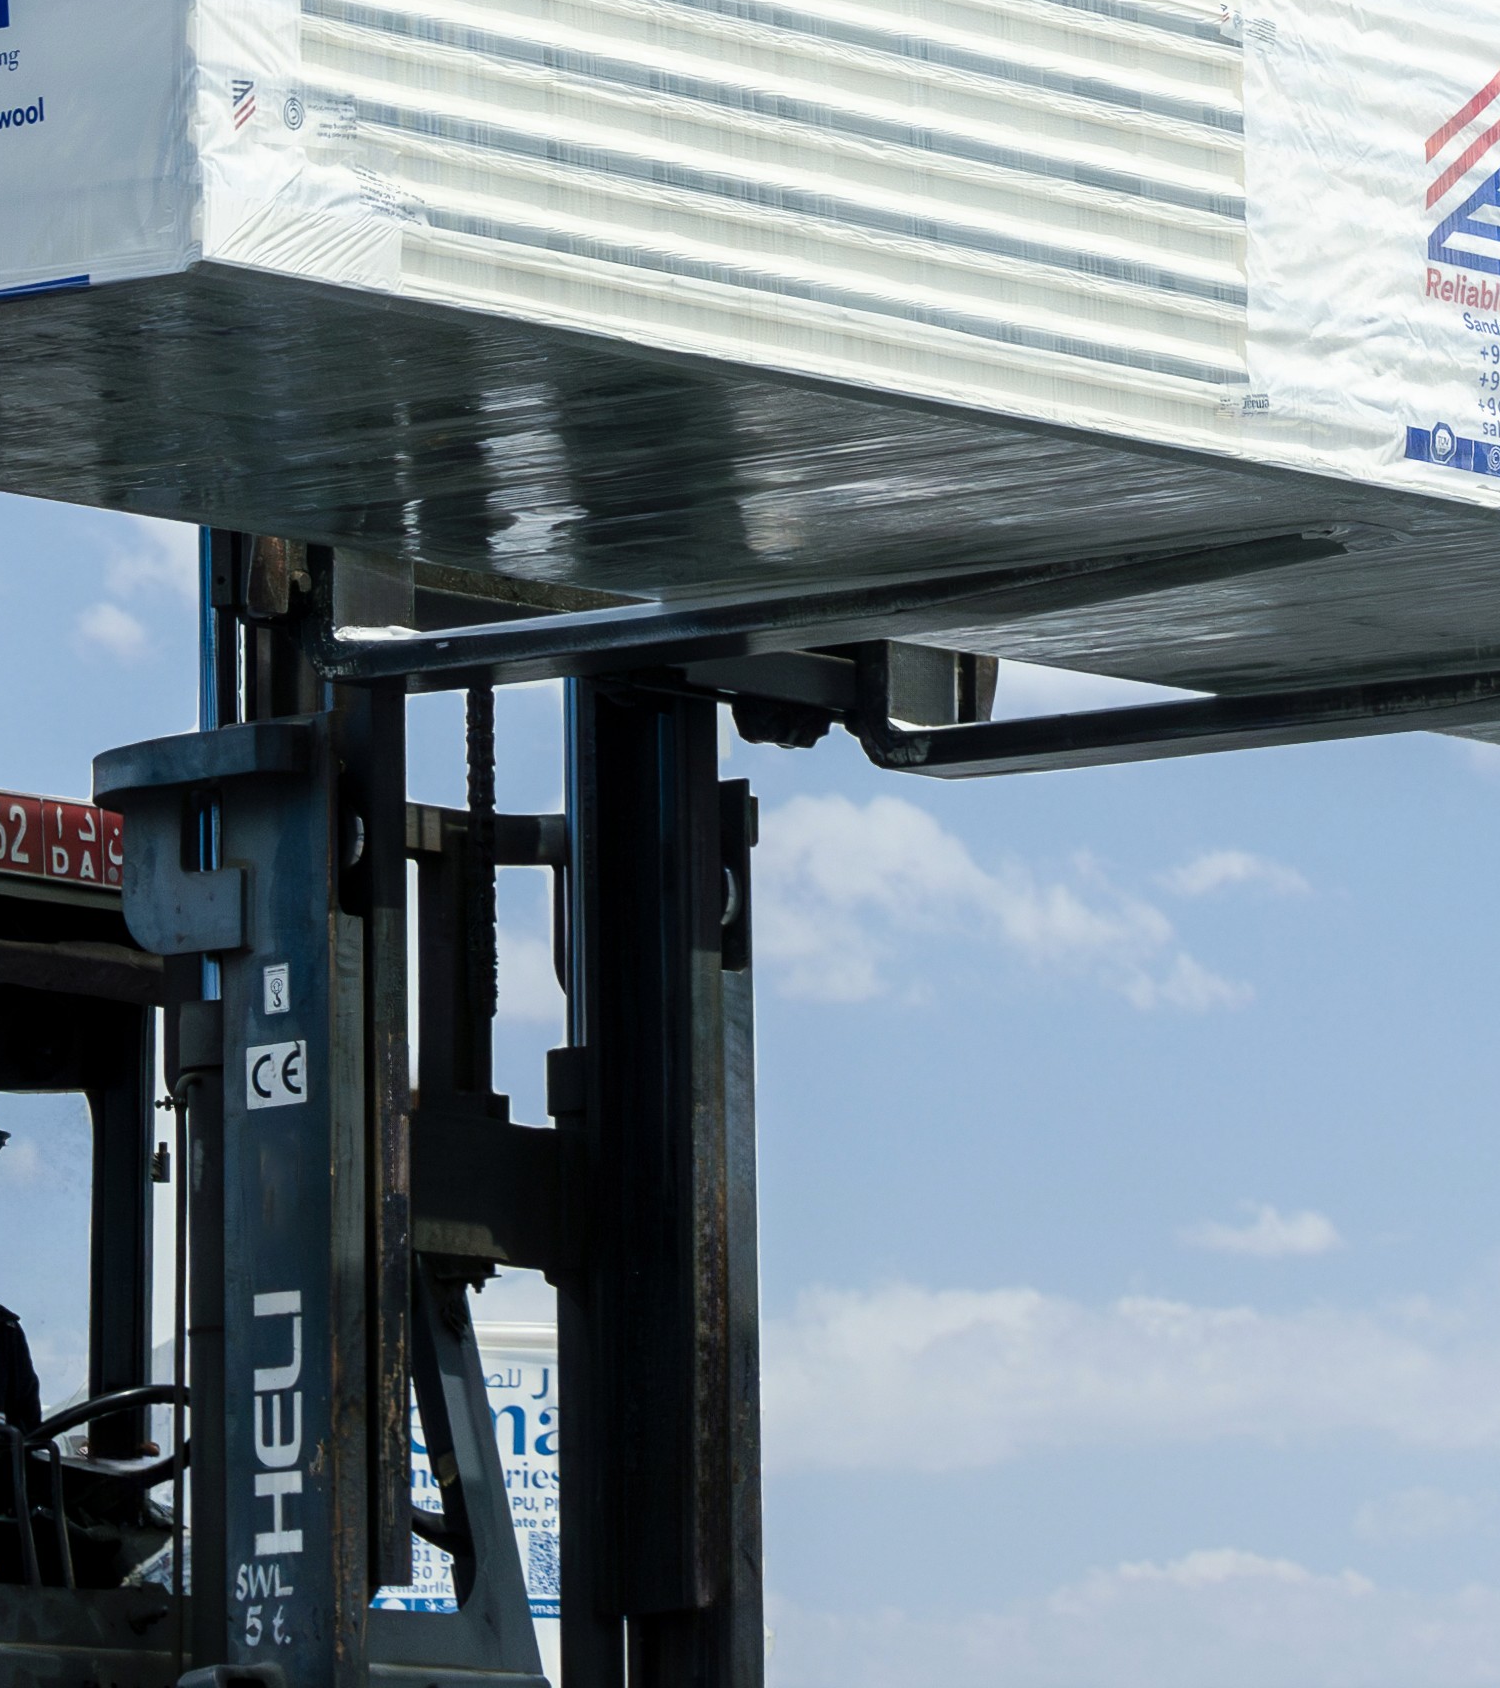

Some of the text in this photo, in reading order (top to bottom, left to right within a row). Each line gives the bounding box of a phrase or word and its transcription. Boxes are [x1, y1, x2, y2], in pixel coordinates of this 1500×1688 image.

[252, 1049, 302, 1098] CE
[253, 1289, 304, 1556] HELI
[512, 1496, 539, 1513] PU,
[235, 1563, 294, 1602] SWL
[245, 1605, 263, 1647] 5
